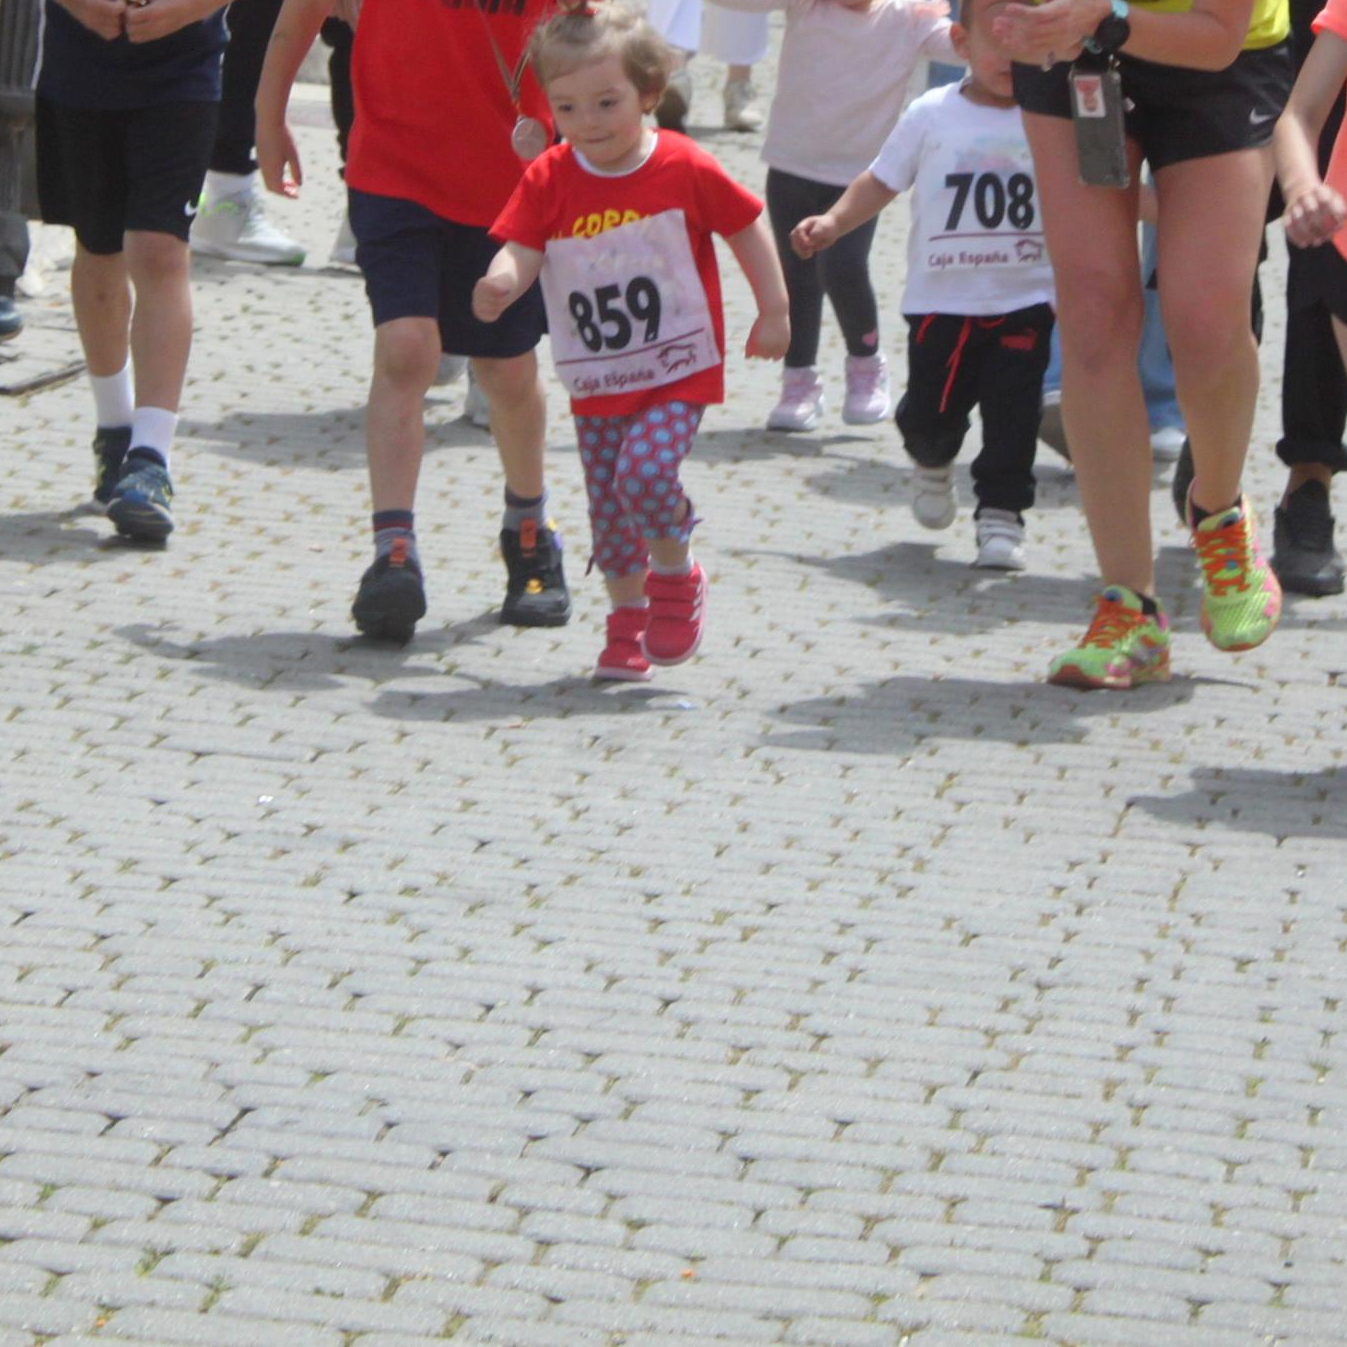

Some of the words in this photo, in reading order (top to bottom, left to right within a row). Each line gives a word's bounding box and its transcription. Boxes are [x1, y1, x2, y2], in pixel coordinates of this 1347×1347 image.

[944, 172, 1034, 231] 708
[928, 253, 953, 270] Caja
[959, 251, 1009, 268] España
[568, 276, 661, 352] 859
[573, 373, 600, 394] Caja
[604, 366, 655, 390] España
